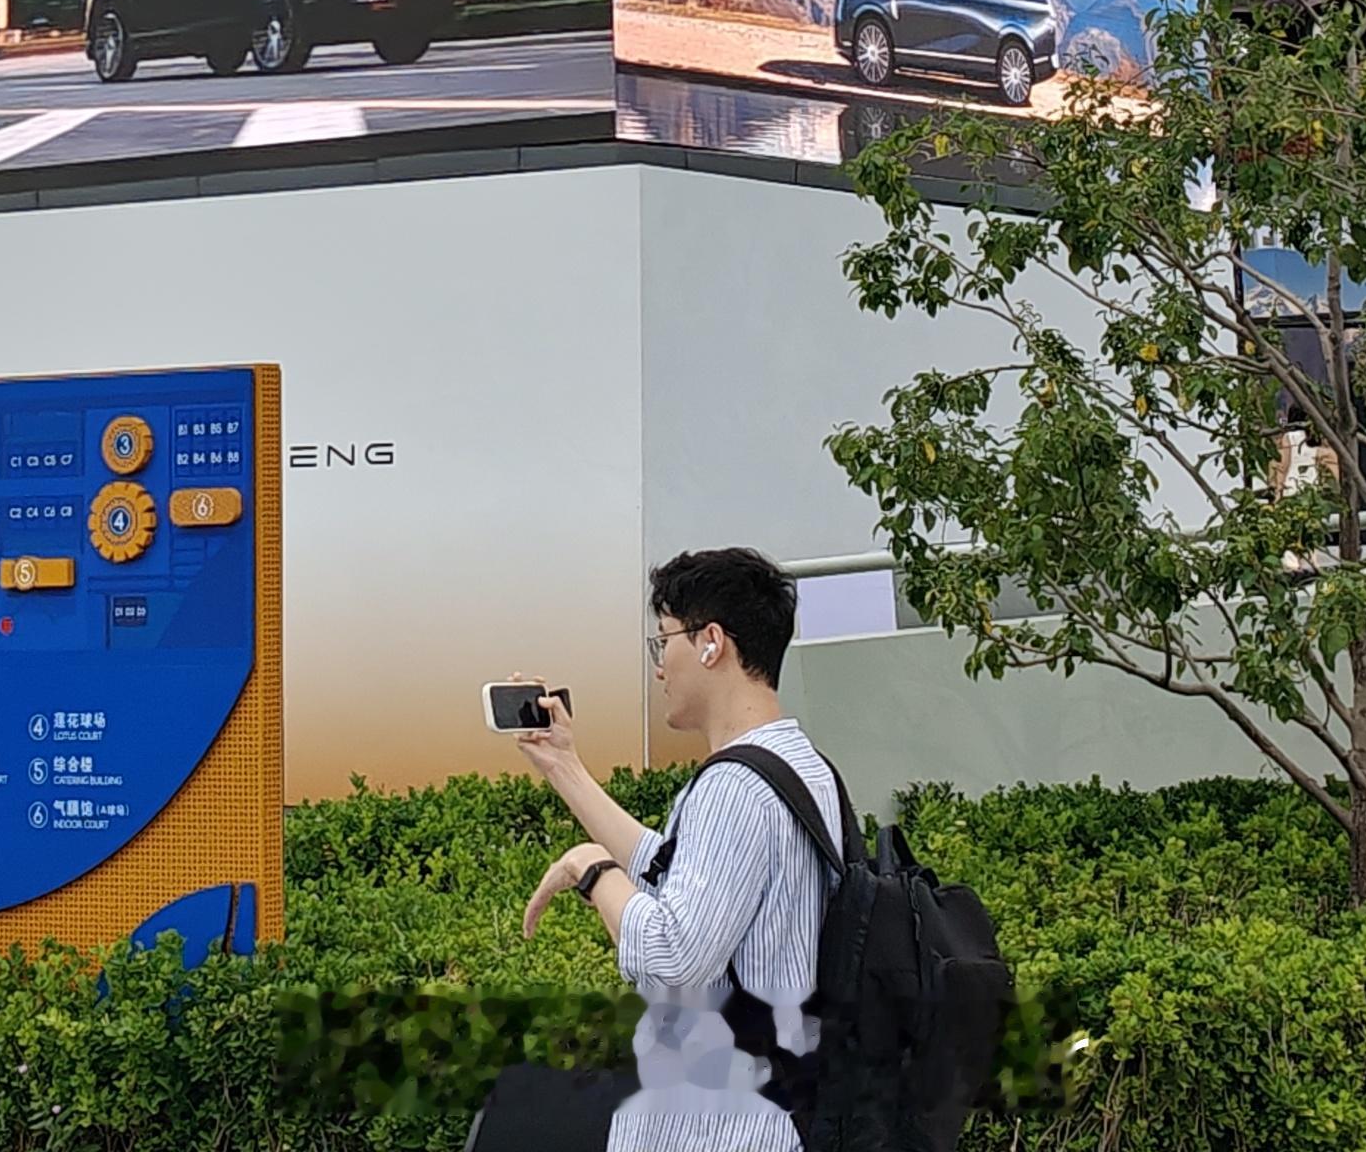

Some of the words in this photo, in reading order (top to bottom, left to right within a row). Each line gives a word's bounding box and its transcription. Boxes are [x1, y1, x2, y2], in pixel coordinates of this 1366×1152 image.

[193, 424, 205, 435] B3
[227, 422, 239, 434] B7
[11, 456, 22, 467] C1
[60, 454, 73, 465] C7
[177, 454, 189, 465] B2
[193, 453, 205, 464] B4
[210, 452, 222, 463] B6
[290, 443, 394, 467] ENG
[9, 508, 22, 519] C2
[27, 507, 38, 518] C4
[53, 712, 106, 728] 莲花球场
[78, 731, 103, 740] COURT
[53, 756, 92, 773] 综合楼
[84, 820, 109, 829] COURT
